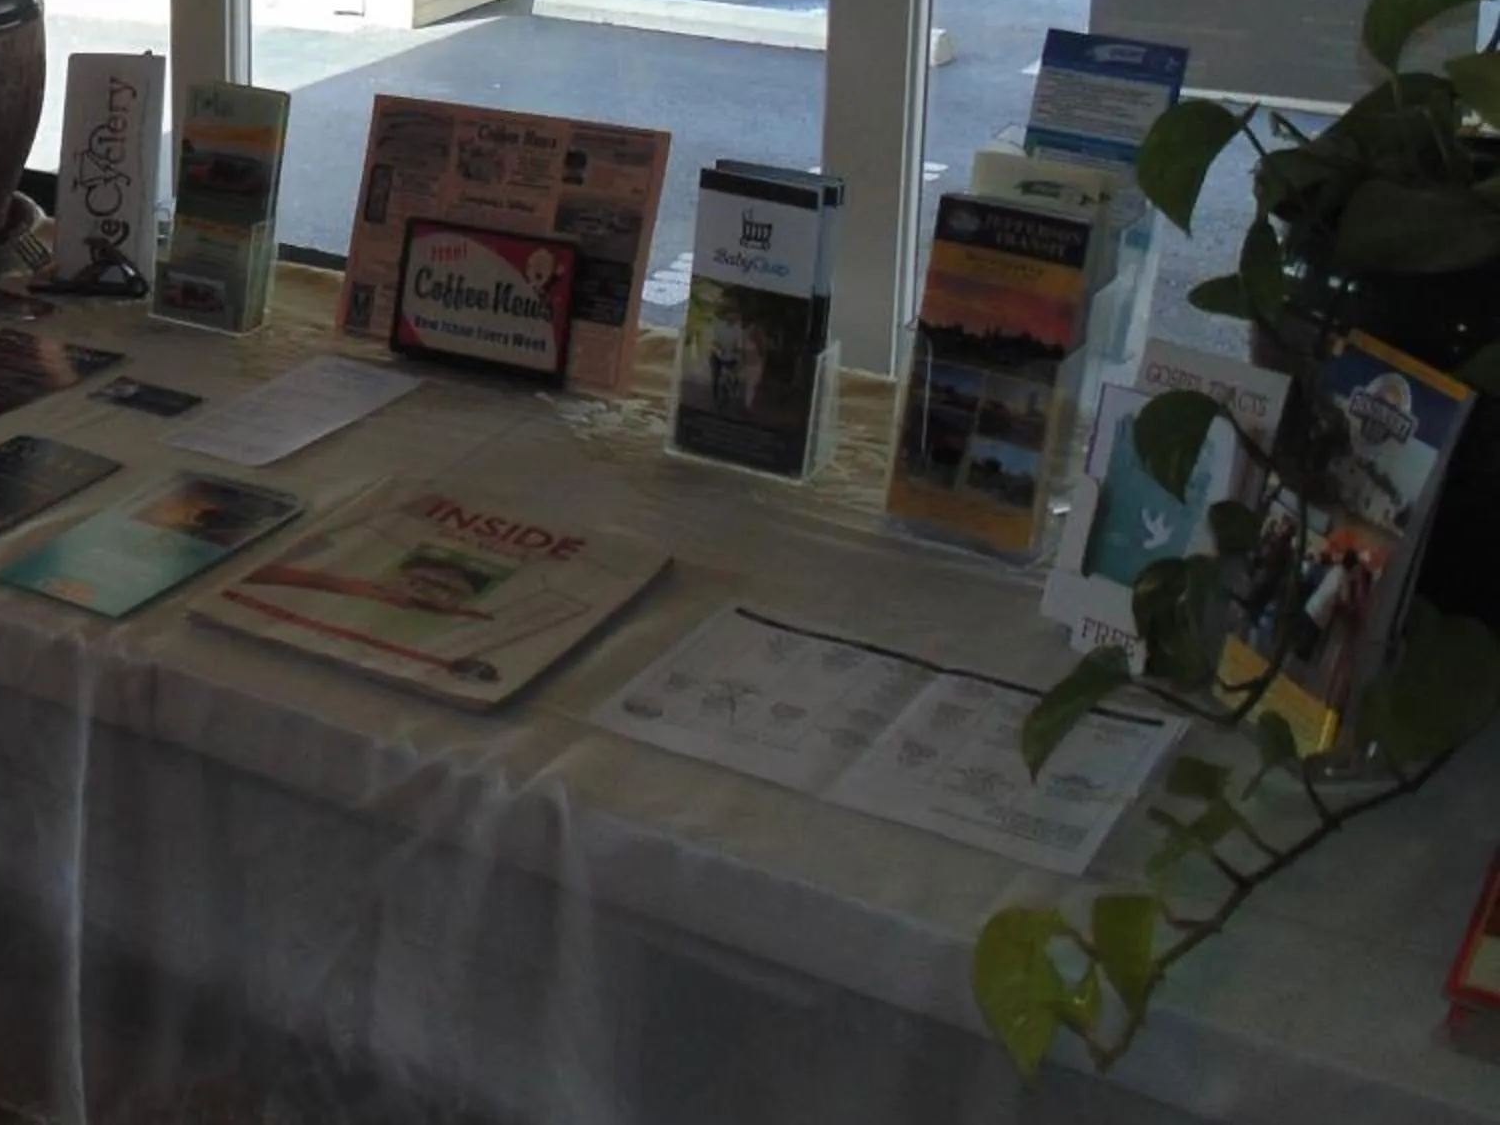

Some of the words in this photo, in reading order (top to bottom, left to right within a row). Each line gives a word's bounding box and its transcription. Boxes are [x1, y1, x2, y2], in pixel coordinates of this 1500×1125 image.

[414, 264, 489, 311] Coffee
[492, 280, 553, 323] News
[425, 497, 586, 561] INSIDE
